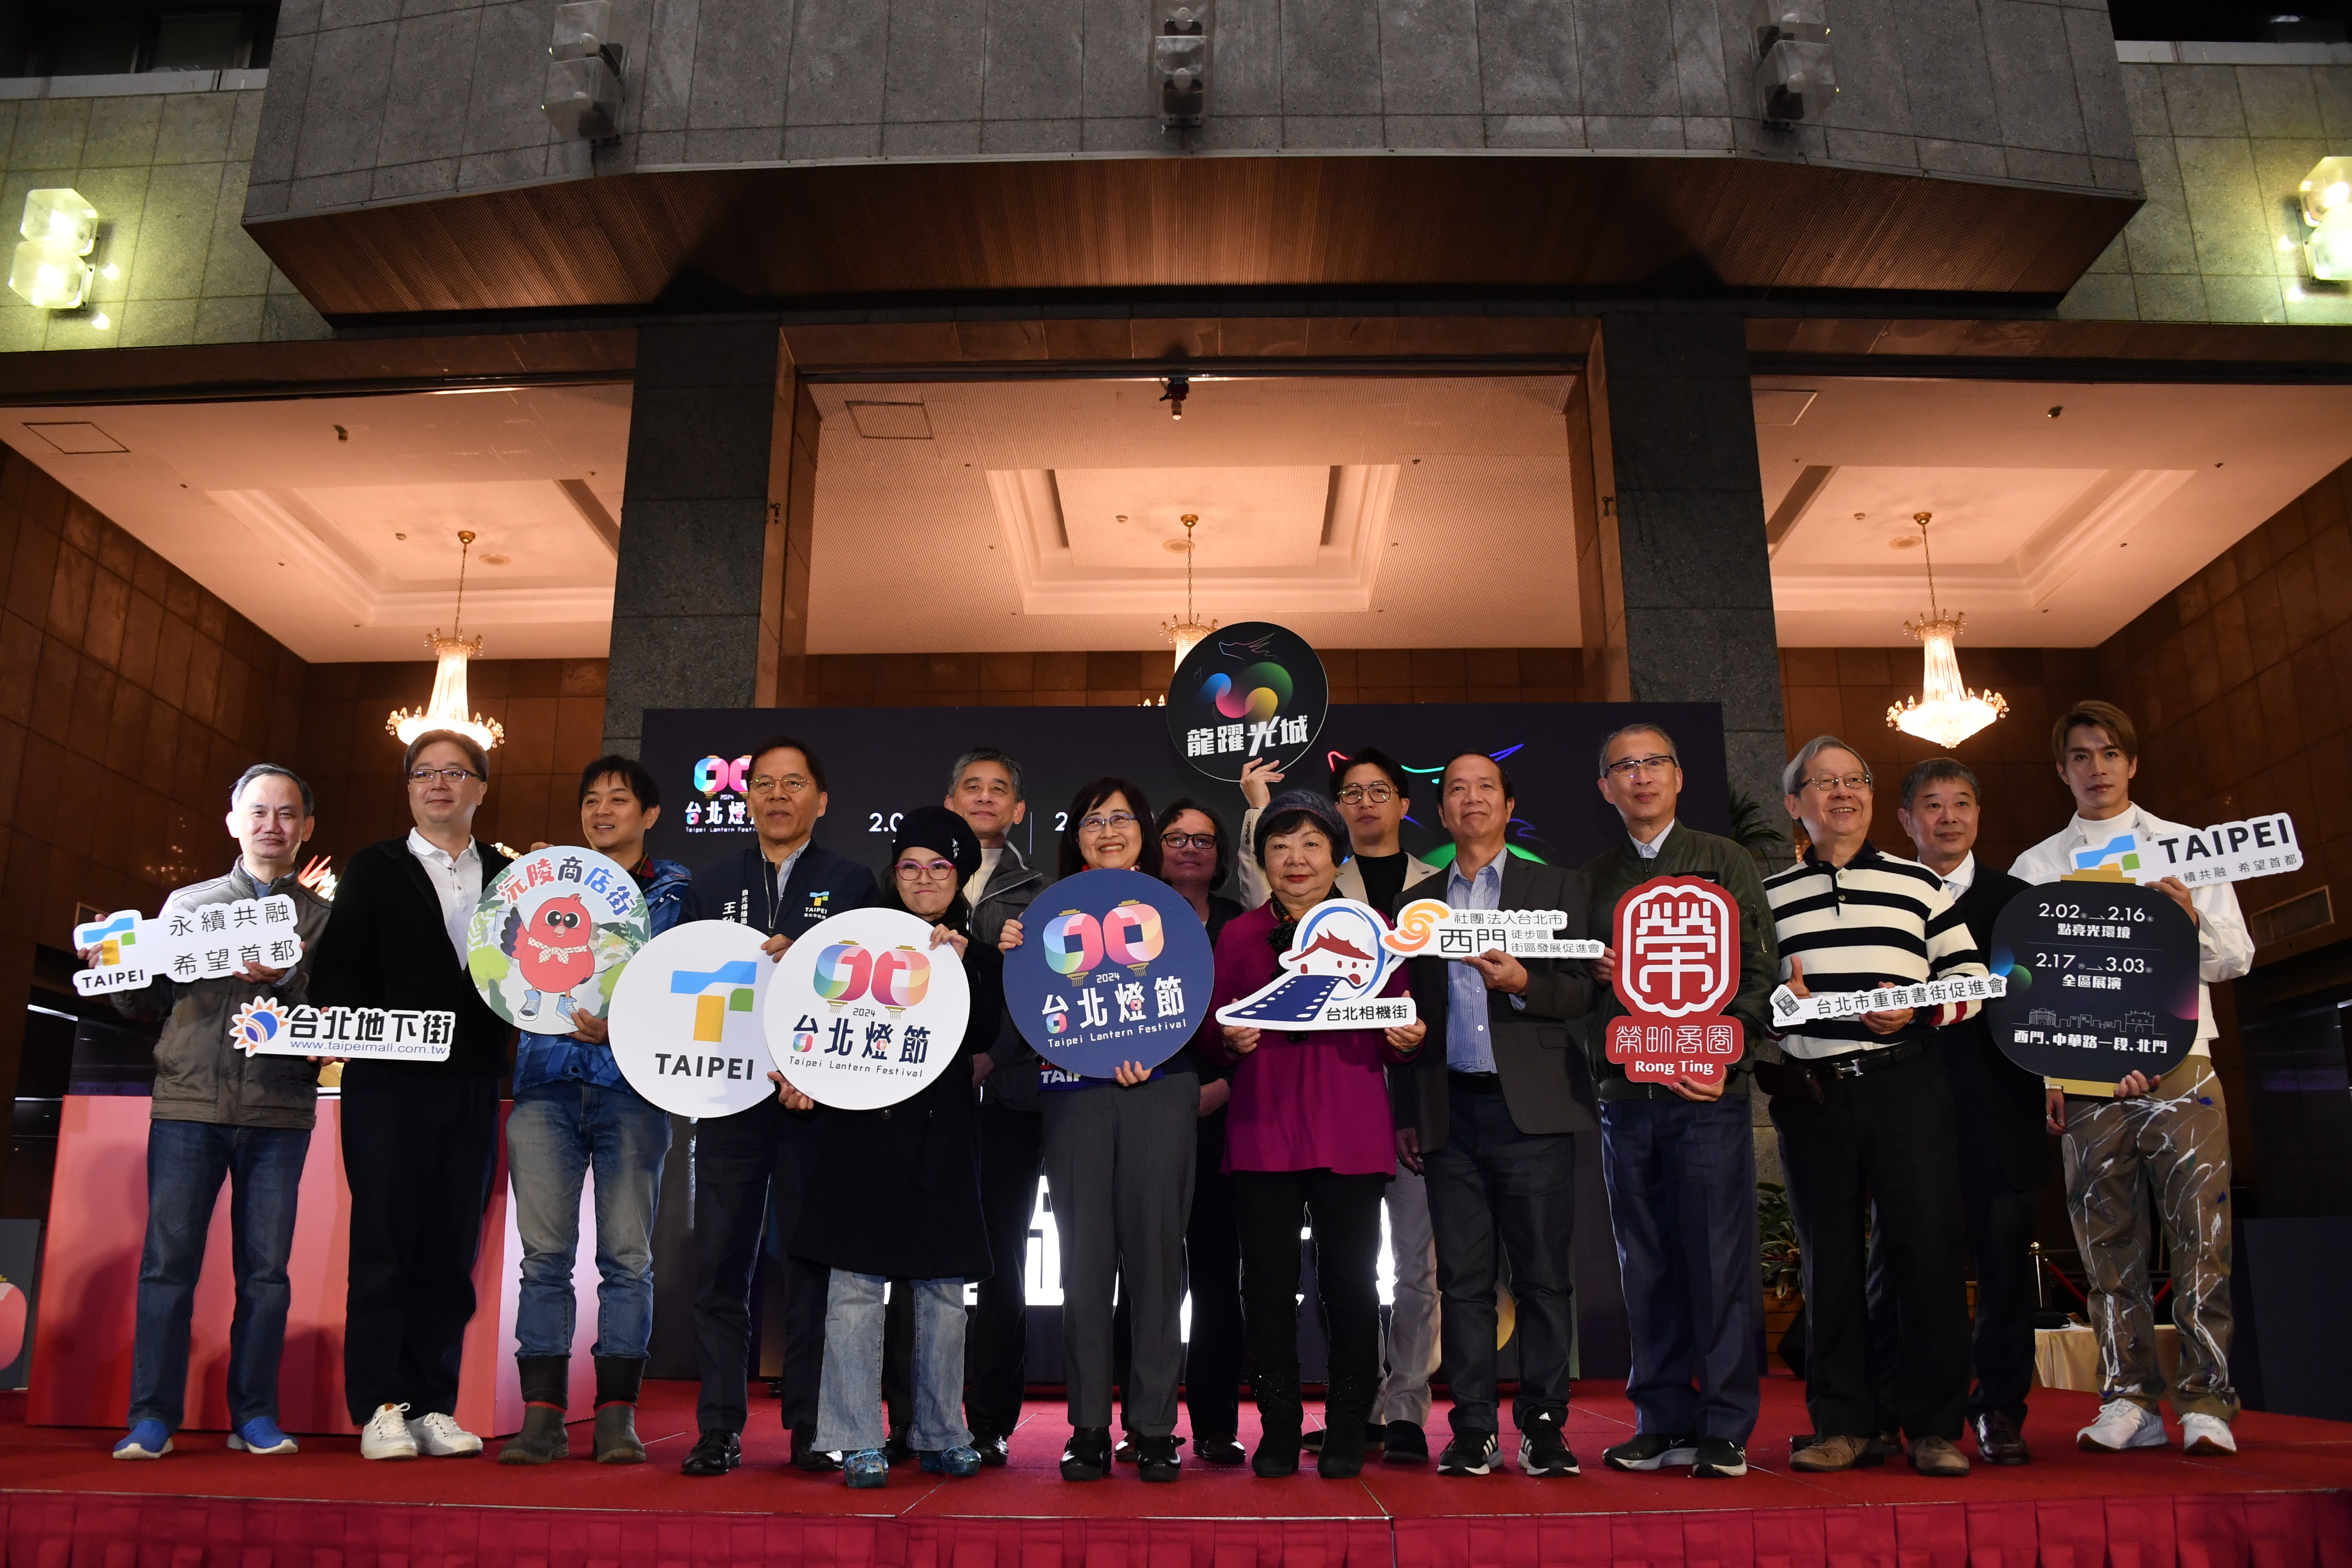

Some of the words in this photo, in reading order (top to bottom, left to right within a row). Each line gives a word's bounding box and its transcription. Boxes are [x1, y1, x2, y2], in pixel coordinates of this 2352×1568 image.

[1187, 714, 1308, 757] 龍躍光城
[685, 801, 755, 825] 台北燈
[2158, 819, 2289, 864] TAIPEI
[2171, 866, 2227, 883] 續共融
[2239, 854, 2297, 874] 希望首都
[498, 856, 636, 916] 沅陵商店街
[169, 900, 291, 936] 永續共融
[1454, 912, 1563, 926] 社團法人台北市
[2038, 902, 2080, 919] 2.02
[2107, 906, 2145, 922] 2.16
[1438, 928, 1507, 953] 西門
[1511, 929, 1549, 940] 徒步區
[2057, 923, 2131, 939] 點亮光環境
[173, 939, 295, 975] 希望首都
[1511, 942, 1600, 954] 街區發展促進會
[2035, 953, 2076, 969] 2.17
[2105, 956, 2145, 974] 3.03
[82, 969, 144, 989] TAIPEI
[1096, 972, 1120, 983] 2024
[2062, 974, 2122, 990] 全區展演
[1042, 976, 1184, 1034] 台北燈節
[1816, 977, 2005, 1016] 台北市重南書街促進會
[852, 1007, 876, 1018] 2024
[1326, 1004, 1407, 1021] 台北相機街
[290, 1008, 452, 1044] 台北地下街
[1048, 1034, 1083, 1048] Taipei
[1090, 1028, 1133, 1041] Lantern
[1138, 1018, 1187, 1034] Festival
[290, 1040, 447, 1054] www.taipeimall.com.tw
[792, 1014, 931, 1064] 台北燈節
[2014, 1029, 2167, 1054] 西門、中華路一段、北門
[655, 1053, 754, 1081] TAIPEI
[789, 1056, 823, 1068] Taipei
[829, 1060, 871, 1073] Lantern
[876, 1065, 923, 1078] Festival
[1635, 1061, 1675, 1075] Rong
[1678, 1060, 1714, 1075] Ting
